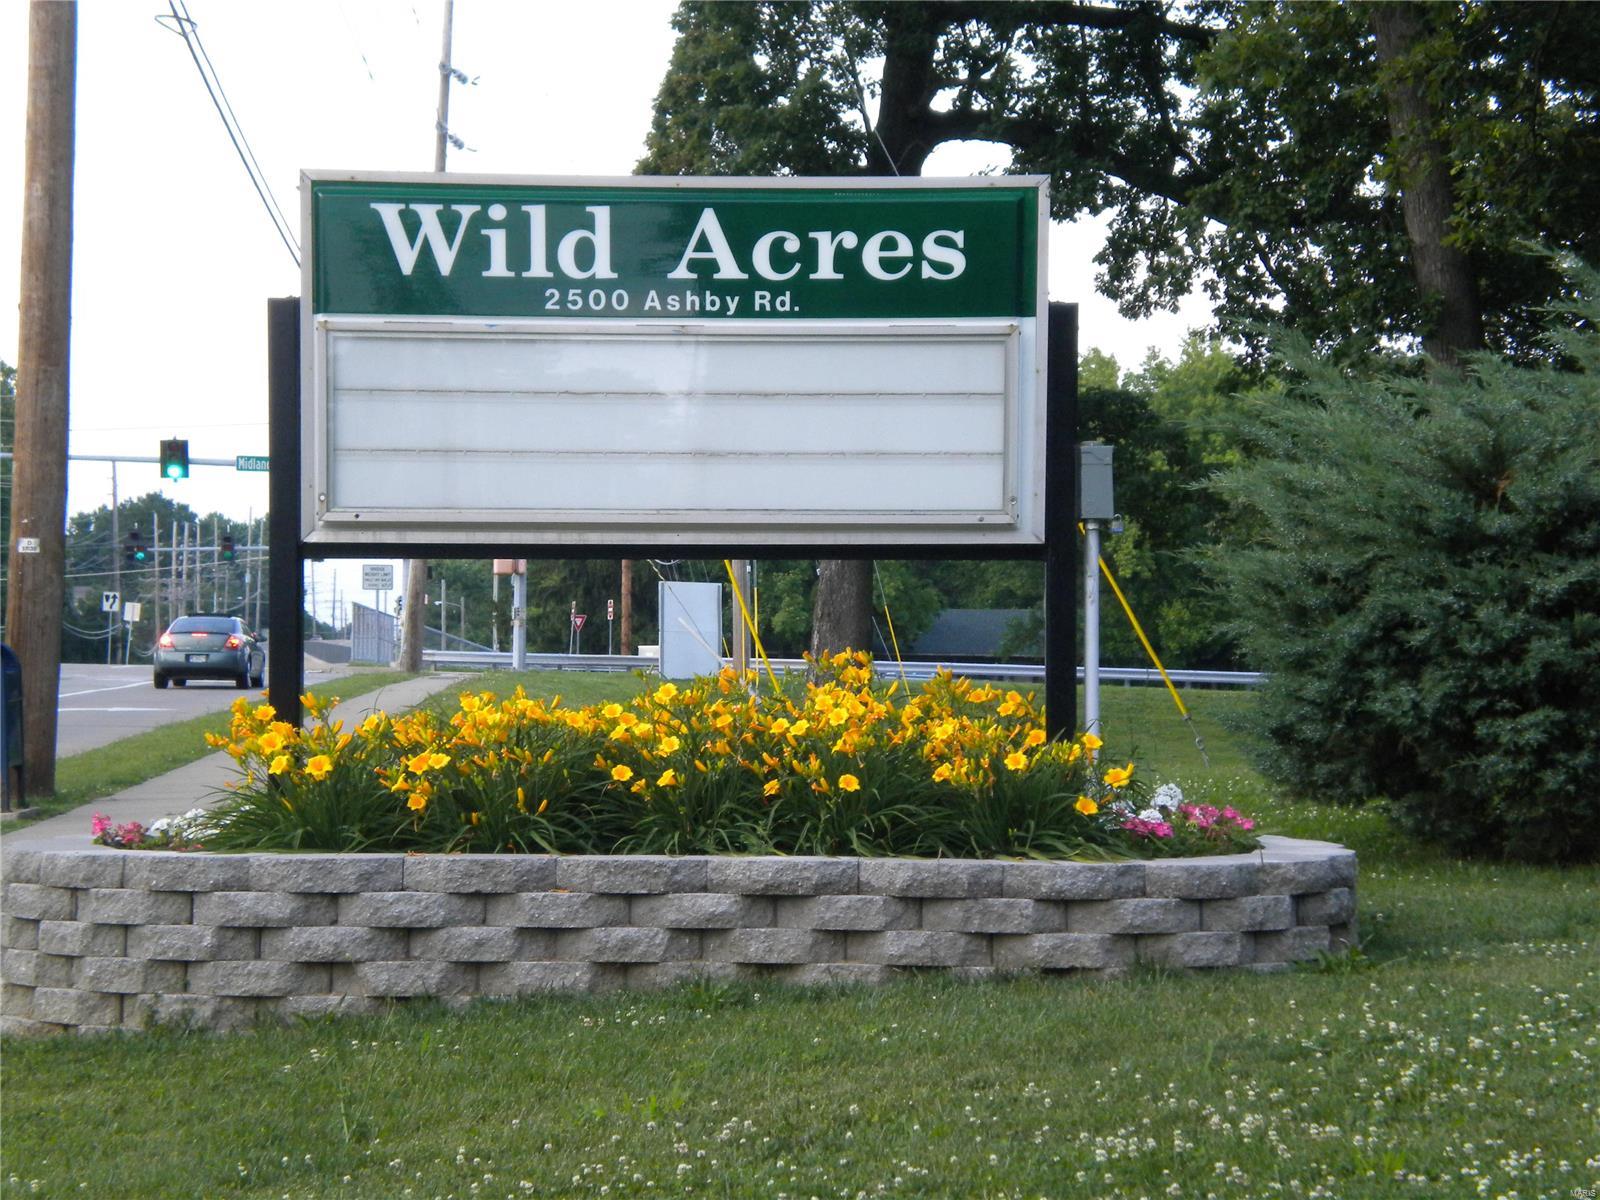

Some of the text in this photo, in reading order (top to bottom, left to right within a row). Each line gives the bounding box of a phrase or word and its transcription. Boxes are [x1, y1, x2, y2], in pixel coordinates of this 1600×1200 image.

[369, 203, 967, 281] Wild Acres
[544, 288, 800, 315] 2500 Ashby Rd.
